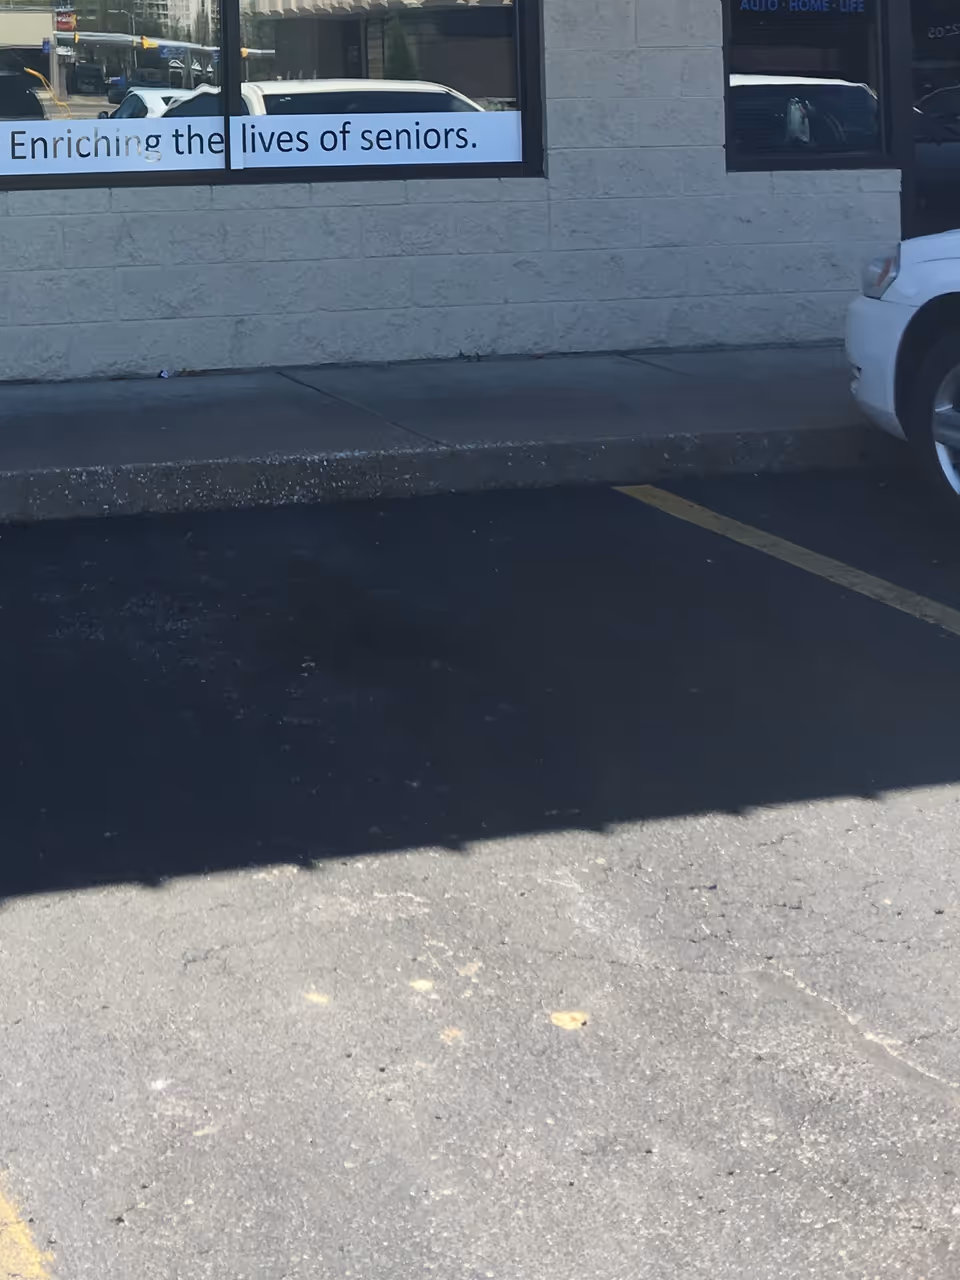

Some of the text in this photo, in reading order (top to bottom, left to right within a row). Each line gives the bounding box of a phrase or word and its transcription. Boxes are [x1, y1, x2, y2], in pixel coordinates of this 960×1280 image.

[840, 0, 865, 12] LIFE
[10, 121, 478, 163] Enriching the lives of seniors.
